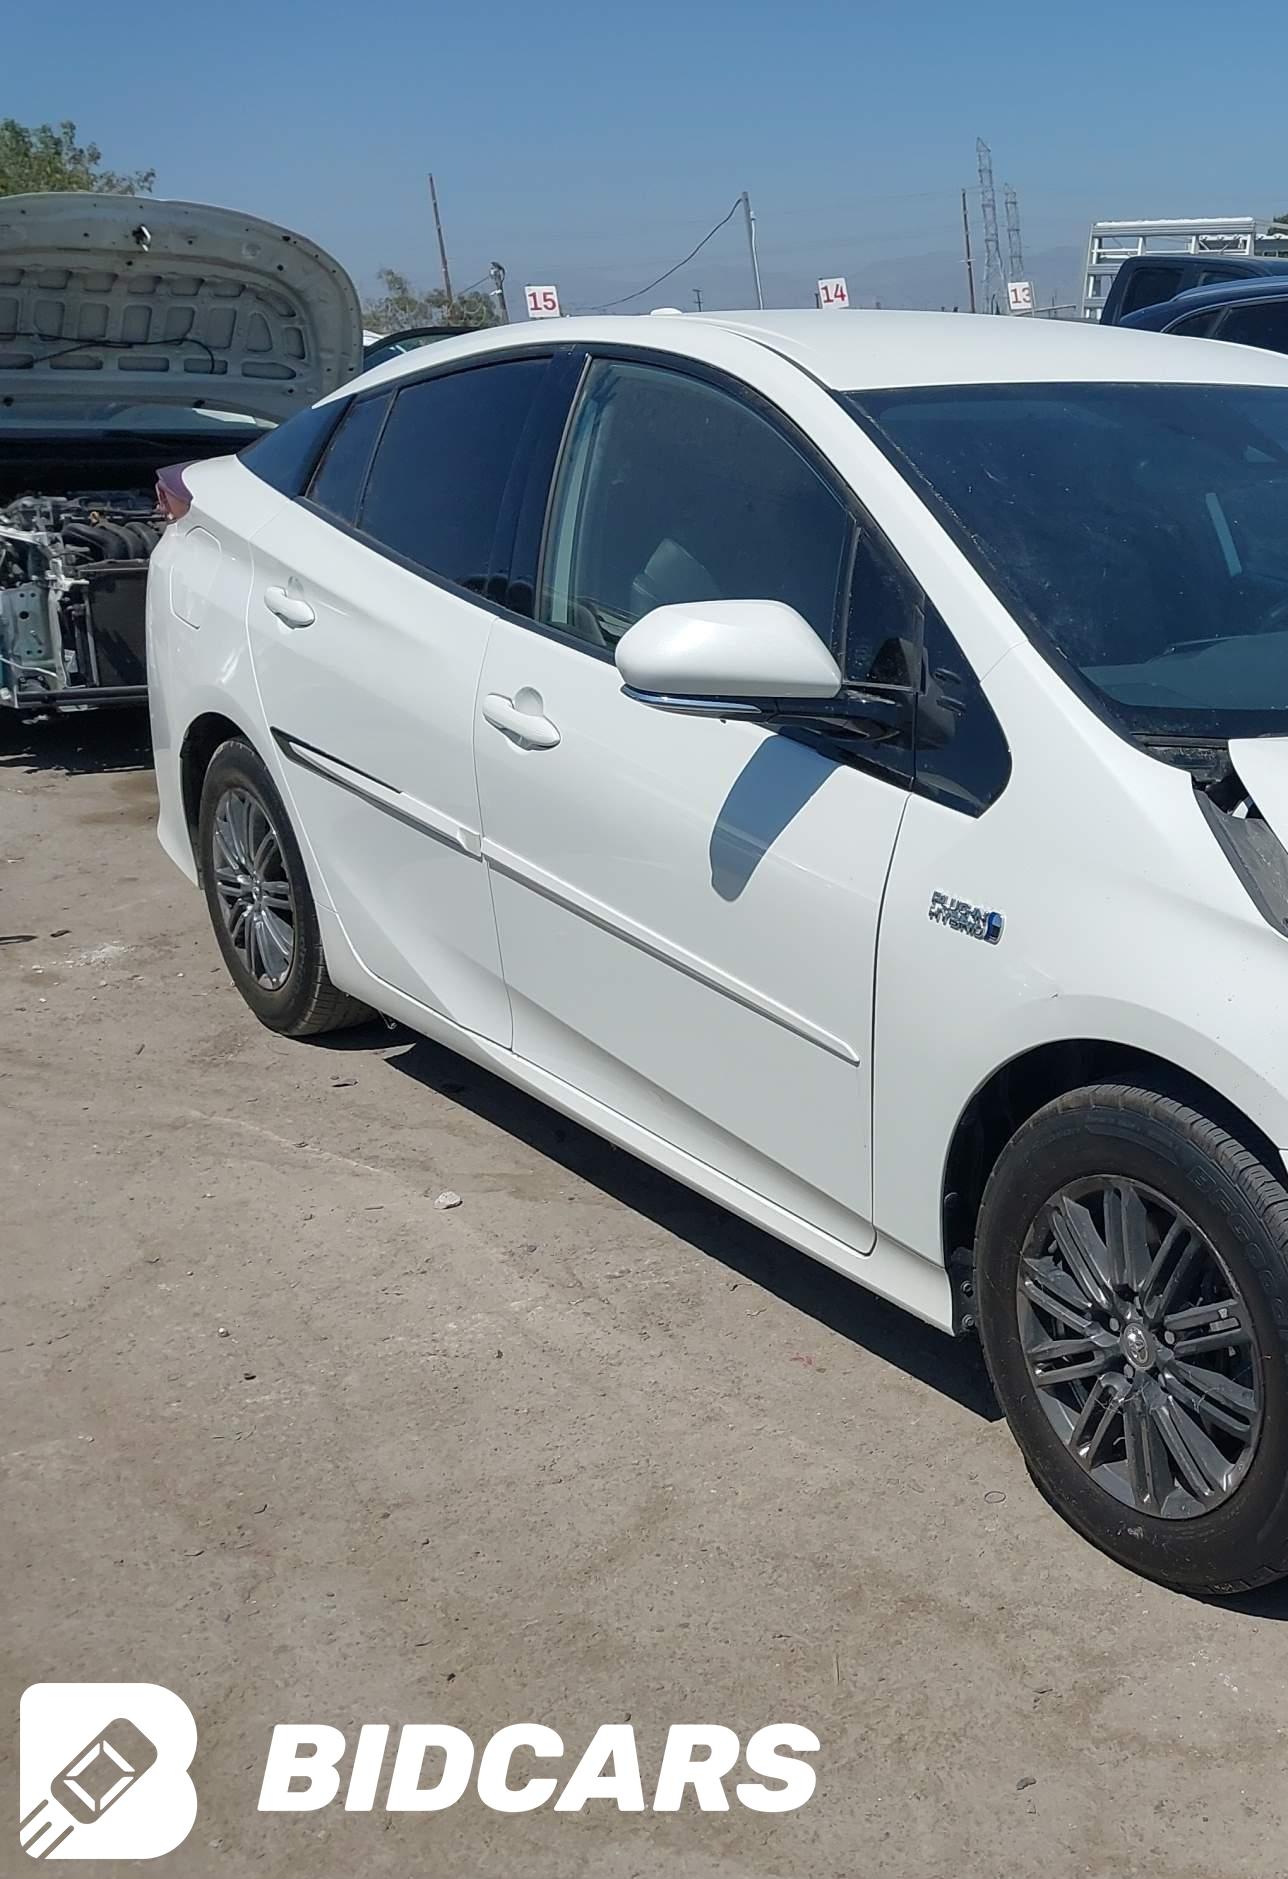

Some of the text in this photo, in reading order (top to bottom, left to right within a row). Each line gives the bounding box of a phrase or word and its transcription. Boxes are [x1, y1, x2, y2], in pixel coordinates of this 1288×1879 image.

[527, 291, 557, 311] 15
[820, 283, 847, 304] 14
[1010, 287, 1032, 304] 13
